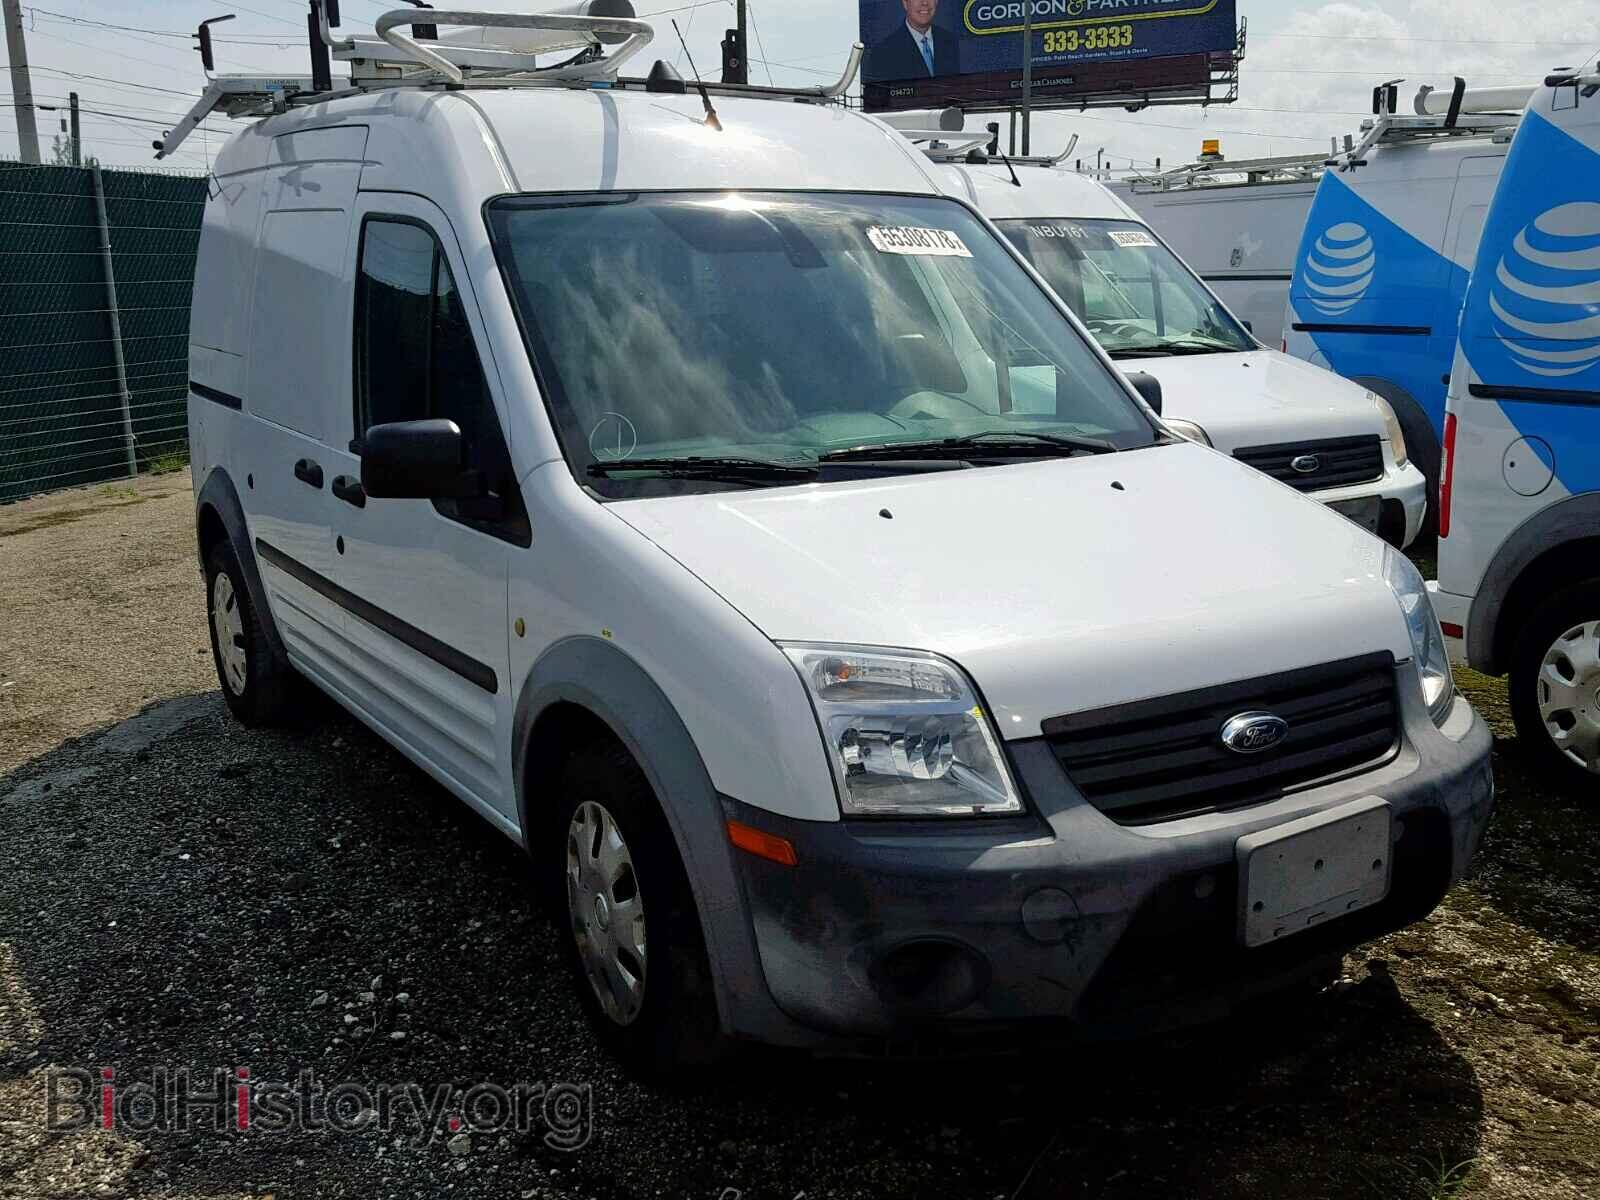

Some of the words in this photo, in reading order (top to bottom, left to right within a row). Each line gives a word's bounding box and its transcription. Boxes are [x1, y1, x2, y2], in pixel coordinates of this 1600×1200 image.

[1043, 24, 1133, 53] 333-3333
[1029, 225, 1089, 239] NBU161
[1243, 724, 1279, 747] Ford
